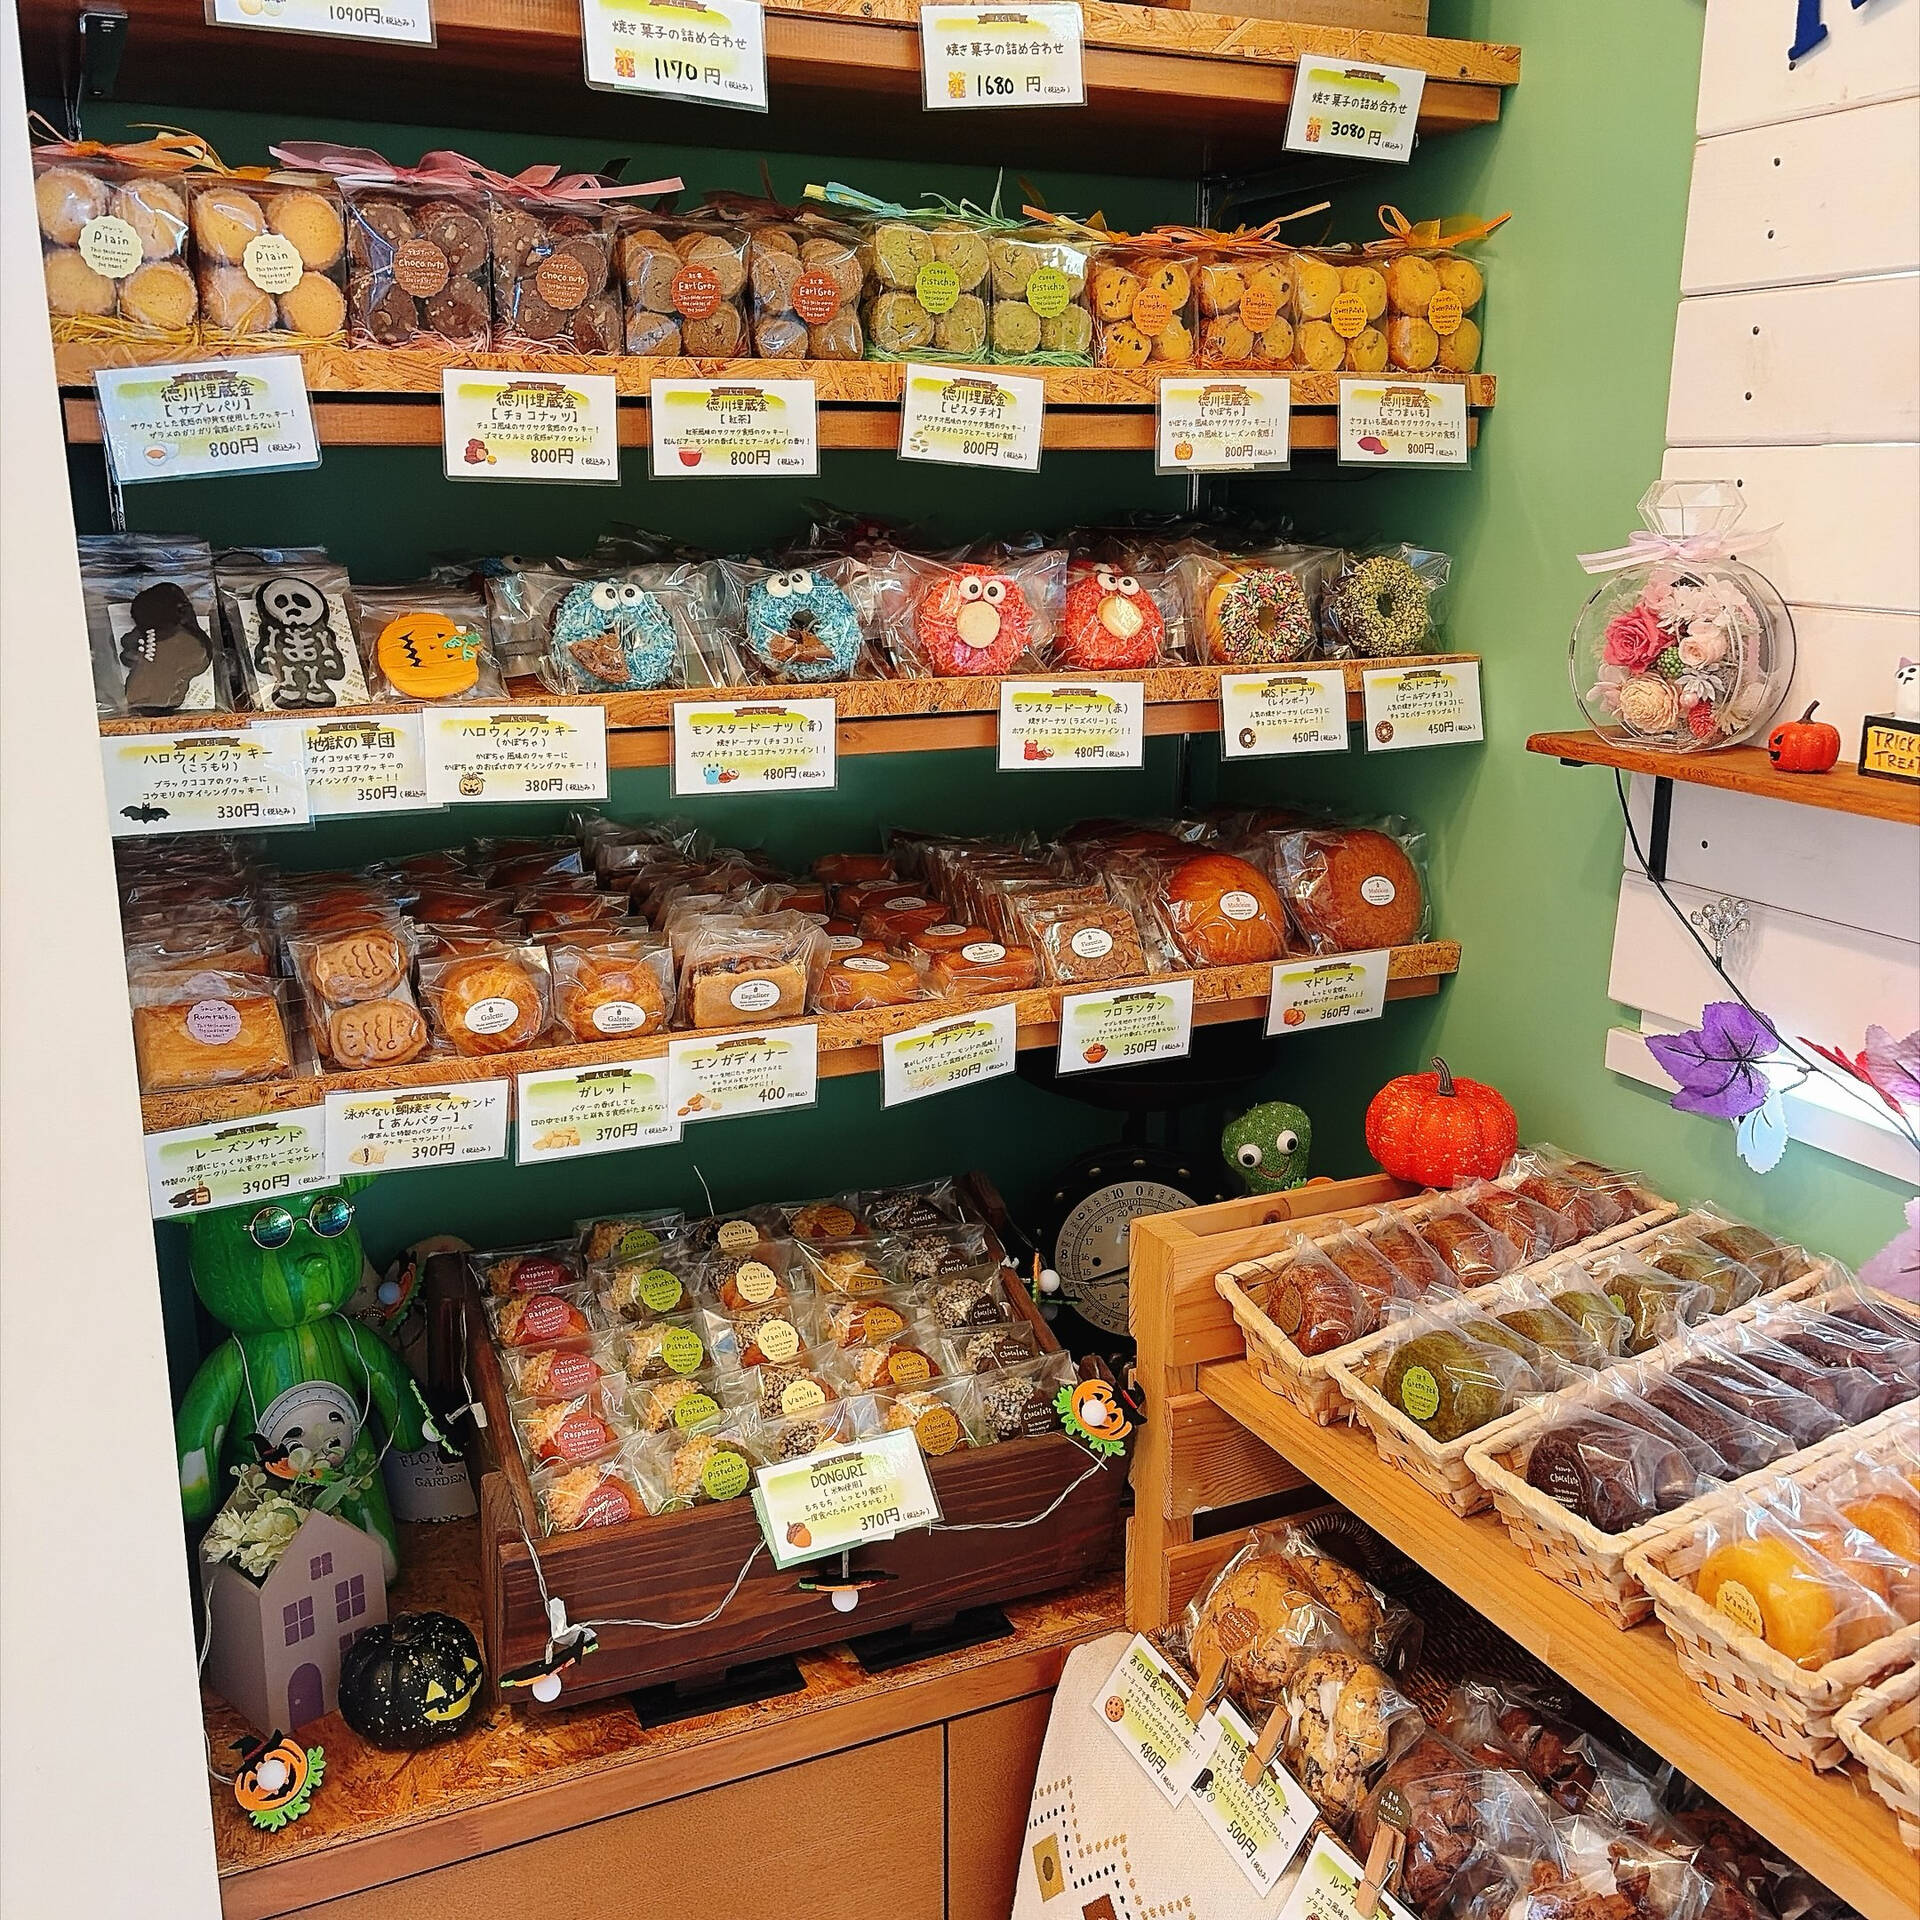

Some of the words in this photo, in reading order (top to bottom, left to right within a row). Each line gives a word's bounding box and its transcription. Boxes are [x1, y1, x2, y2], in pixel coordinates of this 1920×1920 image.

[330, 6, 380, 24] 1090円
[612, 20, 747, 50] 焼き菓子の詰め合わせ
[946, 42, 1064, 57] 焼き菓子の詰め合わせ
[978, 75, 1013, 96] 1680
[94, 231, 128, 245] Plain
[256, 251, 288, 263] Plain
[161, 380, 255, 403] 徳川埋蔵金
[942, 387, 1007, 407] 徳川埋蔵金
[496, 392, 578, 409] 徳川埋蔵金
[706, 398, 769, 412] 徳川埋蔵金
[209, 437, 258, 458] 800円
[531, 448, 574, 464] 800円
[963, 440, 999, 457] 800円
[1225, 444, 1253, 458] 800円
[1408, 442, 1434, 455] 800円
[730, 450, 771, 466] 800円
[462, 726, 578, 738] ハロウィンクッキー
[1428, 721, 1454, 734] 450円
[307, 732, 395, 752] 地獄の軍団
[1292, 730, 1319, 743] 450円
[1874, 730, 1915, 752] TRICK
[144, 747, 273, 765] ハロウィンクッキー
[1075, 745, 1104, 758] 480円
[763, 767, 797, 780] 480円
[358, 786, 398, 801] 350円
[525, 778, 563, 792] 380円
[217, 803, 259, 819] 330円
[1304, 973, 1355, 989] マドレーヌ
[1104, 1002, 1166, 1018] フロランタン
[1321, 1005, 1350, 1019] 360円
[916, 1028, 985, 1052] フィナンシェ
[1123, 1039, 1157, 1056] 350円
[691, 1049, 788, 1071] エンガディナー
[948, 1063, 981, 1081] 330円
[579, 1082, 632, 1098] ガレット
[758, 1086, 786, 1103] 400
[596, 1123, 638, 1141] 370円
[195, 1130, 303, 1160] レーズンサンド
[412, 1142, 454, 1159] 390円
[242, 1174, 290, 1195] 390円
[1111, 1188, 1124, 1199] 10
[414, 1473, 467, 1488] GARDEN
[810, 1463, 867, 1488] DONGURI
[859, 1507, 901, 1531] 370円
[1139, 1742, 1167, 1774] 480円
[1226, 1820, 1257, 1859] 500円
